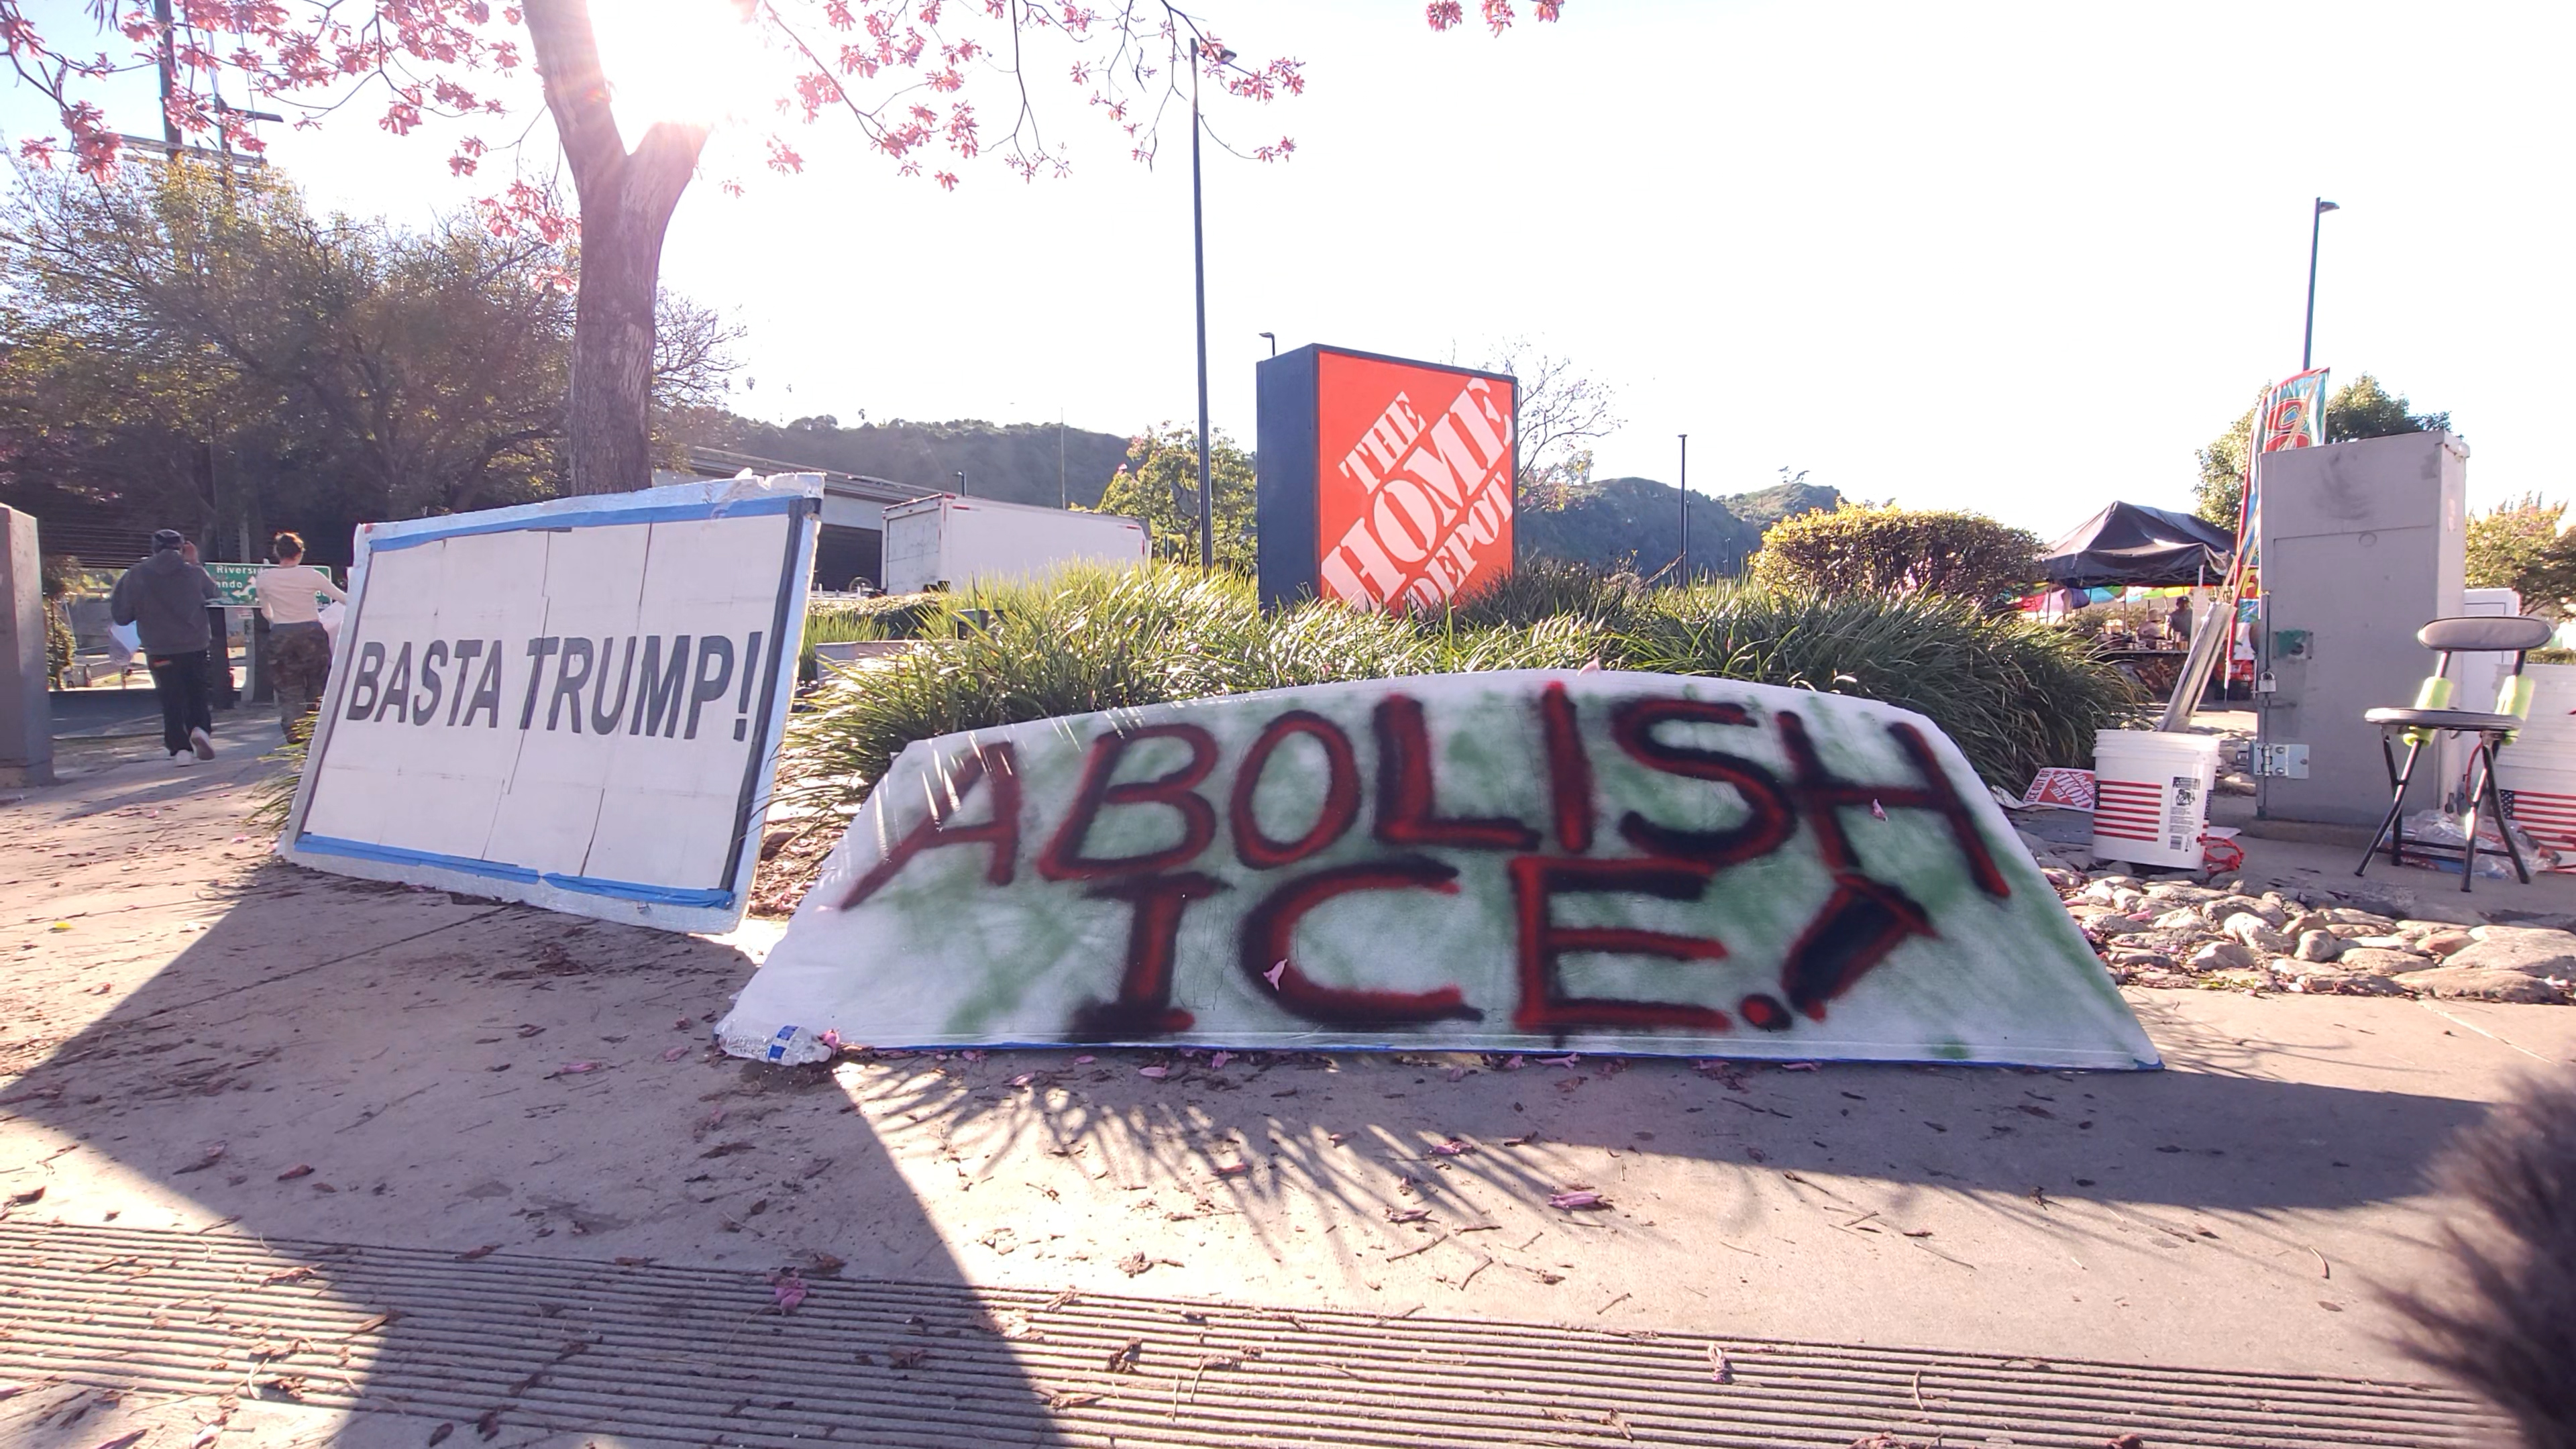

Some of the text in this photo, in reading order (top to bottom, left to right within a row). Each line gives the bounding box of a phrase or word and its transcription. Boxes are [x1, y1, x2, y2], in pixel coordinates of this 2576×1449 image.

[1321, 377, 1512, 614] HOME
[1338, 391, 1426, 494] THE
[216, 565, 264, 574] Riversid
[1402, 471, 1513, 612] DEPOT
[345, 631, 763, 742] BASTA TRUMP!
[840, 680, 2011, 912] ABOLISH
[2025, 769, 2051, 802] ICE OUT OF
[2052, 771, 2093, 807] HOME
[1067, 857, 1941, 1043] ICE!
